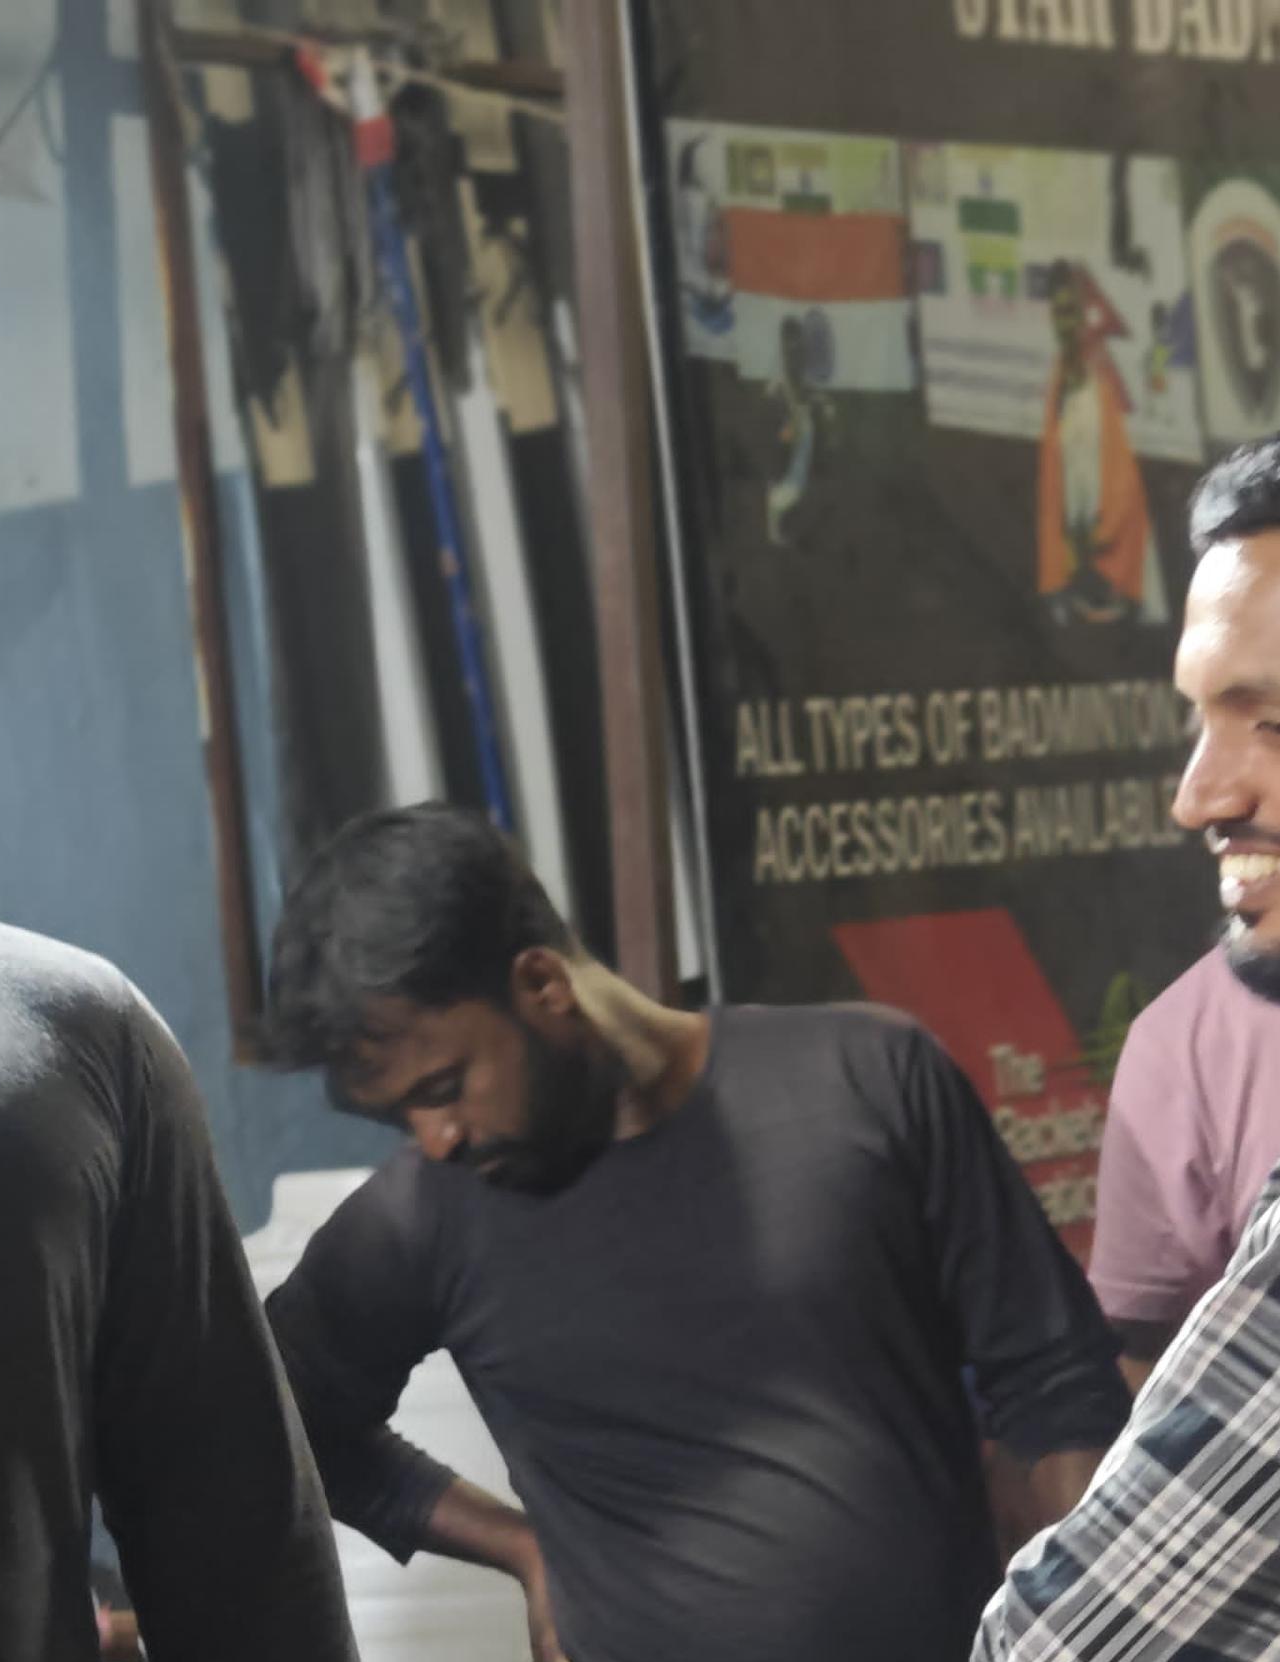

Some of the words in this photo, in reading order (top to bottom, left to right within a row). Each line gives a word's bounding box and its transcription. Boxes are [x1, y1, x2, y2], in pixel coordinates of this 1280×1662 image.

[735, 698, 804, 777] ALL
[805, 691, 916, 774] TYPES
[925, 689, 975, 765] OF
[754, 795, 1005, 882] ACCESSORIES
[1015, 776, 1184, 855] AVAILABLE
